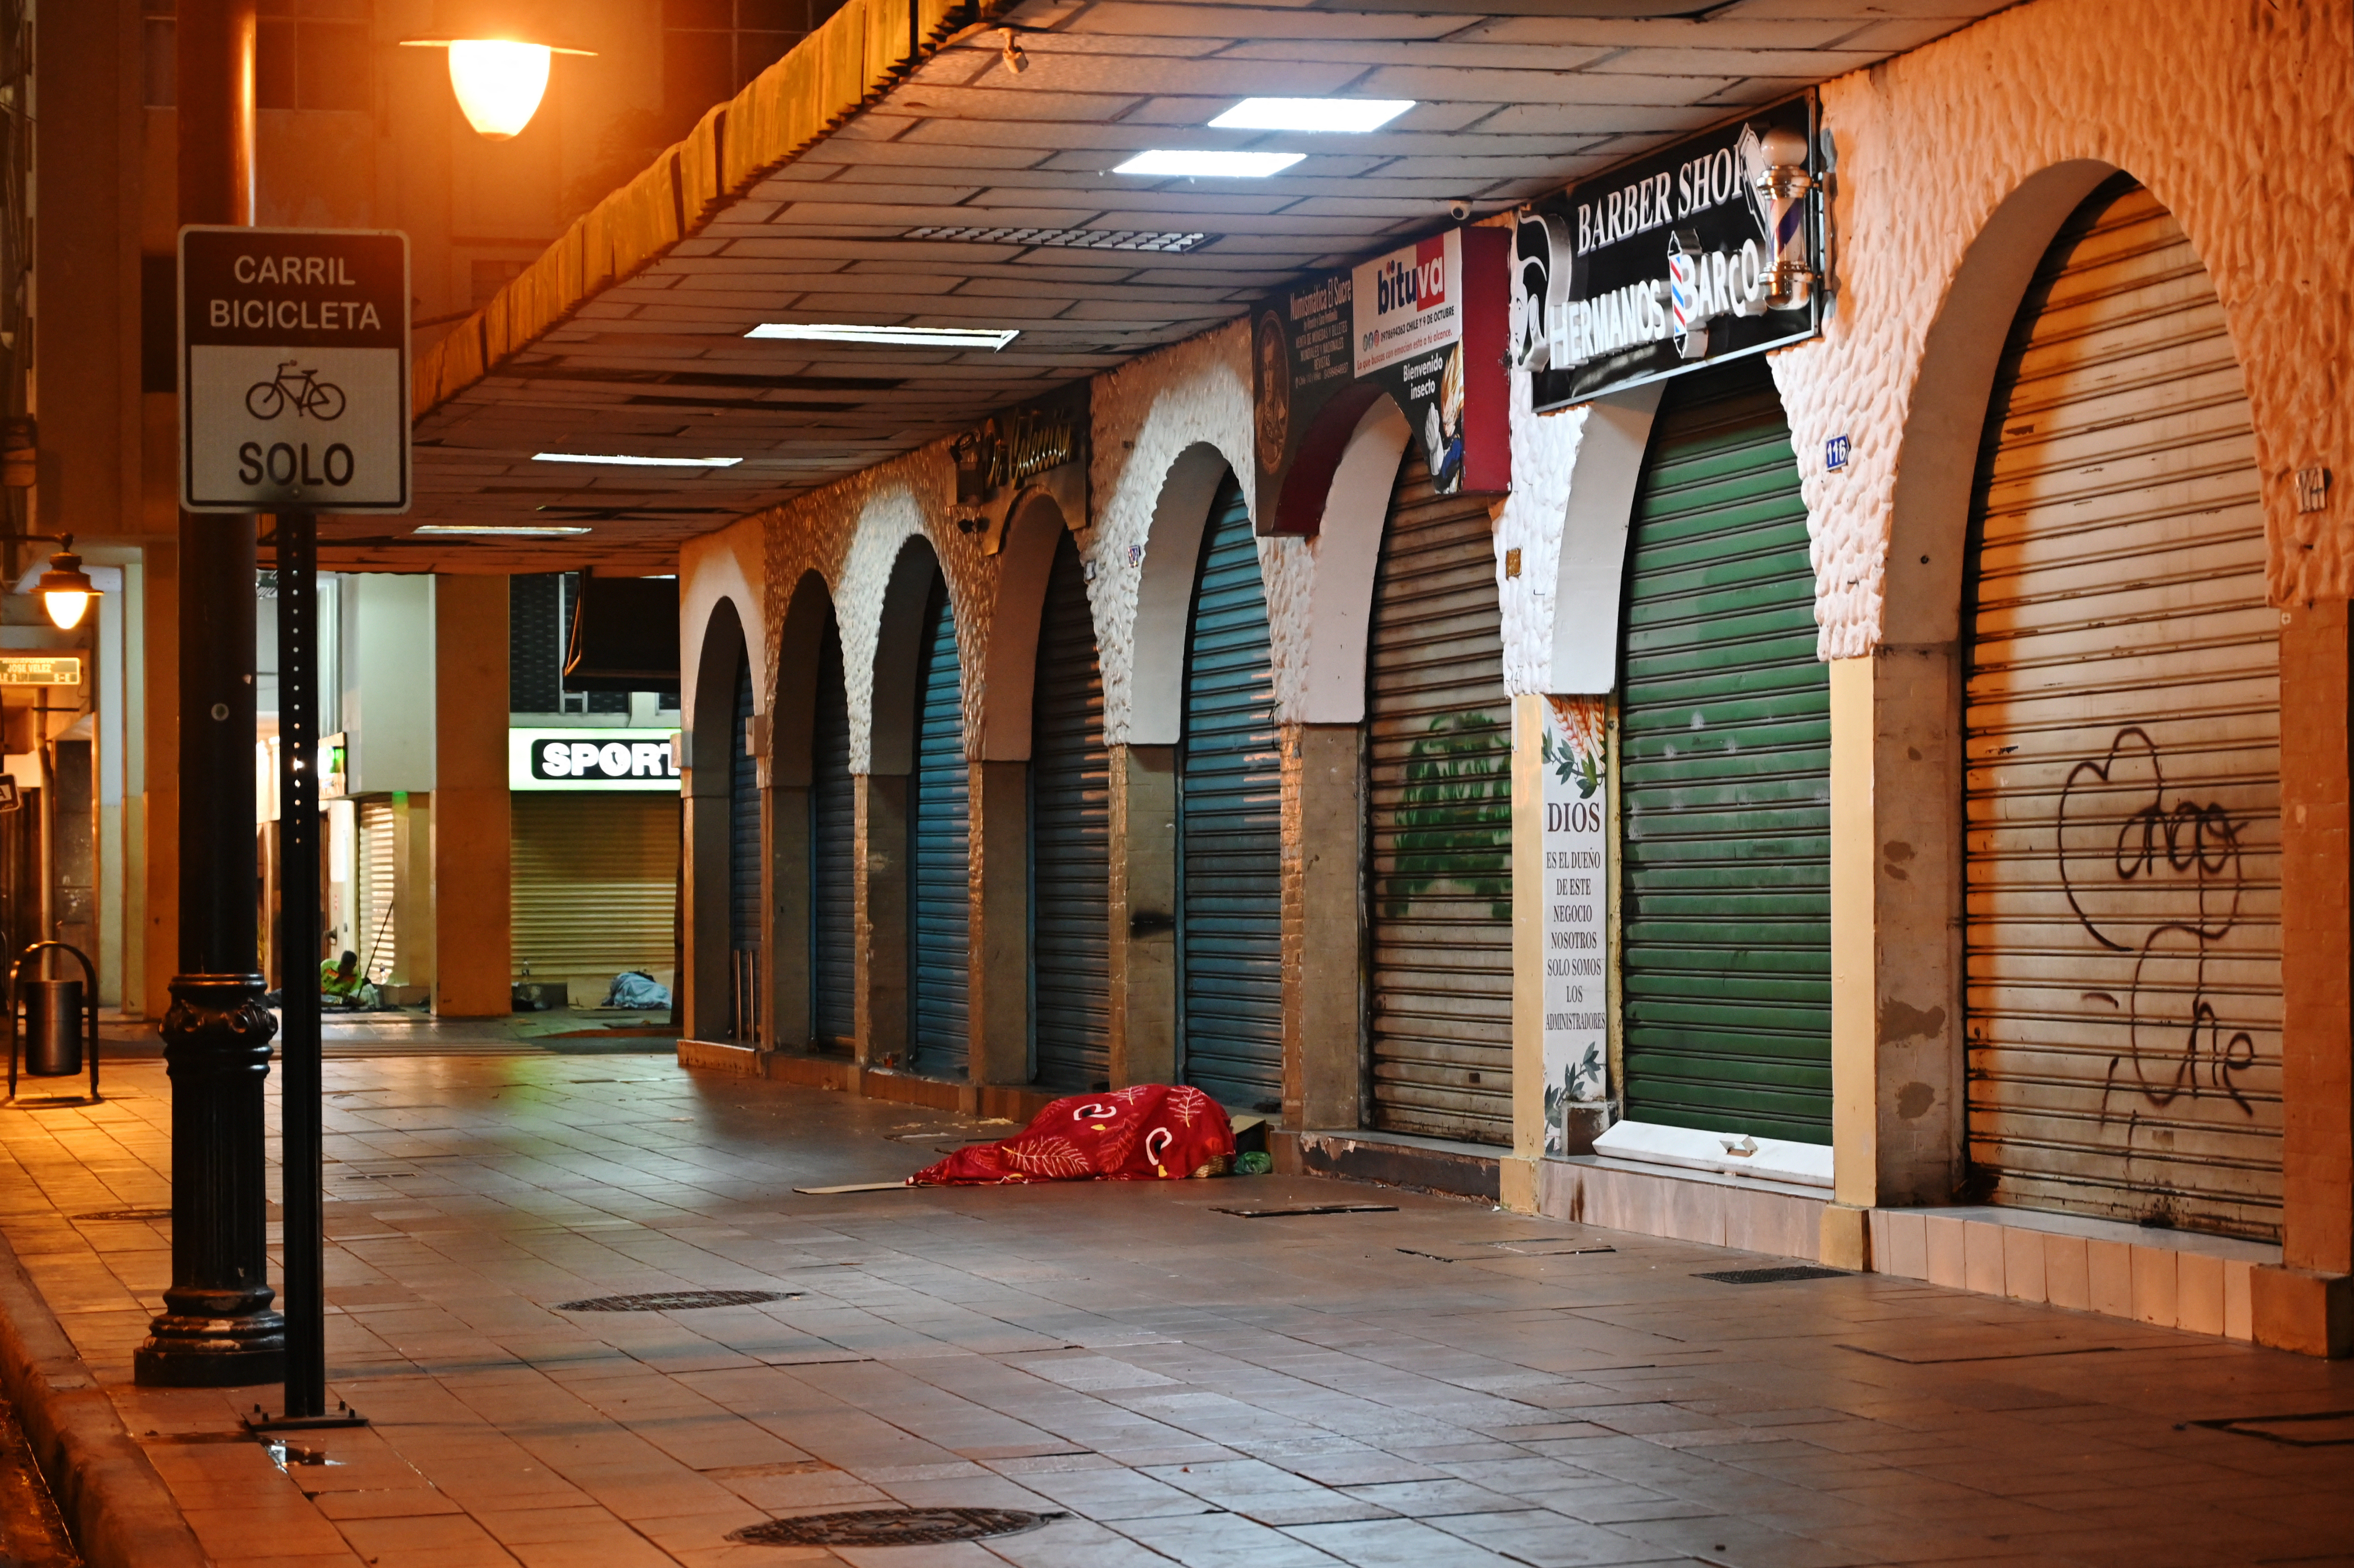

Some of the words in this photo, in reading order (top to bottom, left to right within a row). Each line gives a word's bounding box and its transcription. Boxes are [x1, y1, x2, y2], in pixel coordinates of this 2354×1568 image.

[1578, 171, 1672, 257] BARBER
[234, 255, 355, 285] CARRIL
[1290, 284, 1327, 321] Numismática
[1328, 277, 1333, 308] El
[1334, 276, 1351, 306] Sucre
[1378, 256, 1443, 315] bituva
[210, 300, 381, 329] BICICLETA
[1549, 279, 1665, 370] HERMANOS
[1681, 238, 1760, 324] BARCO
[1406, 318, 1419, 332] CHILE
[1419, 318, 1423, 328] Y
[1423, 316, 1426, 325] 9
[1427, 314, 1433, 325] DE
[1434, 306, 1454, 322] OCTUBRE
[1357, 360, 1363, 370] Lo
[1363, 358, 1371, 370] que
[1371, 353, 1385, 364] buscas
[1413, 336, 1423, 349] está
[1403, 352, 1443, 381] Bienvenido
[1410, 379, 1435, 400] insecto
[238, 442, 354, 486] SOLO
[1828, 439, 1846, 464] 116
[28, 664, 51, 672] VELEZ
[1548, 802, 1600, 833] DIOS
[1547, 852, 1556, 869] ES
[1559, 852, 1569, 869] EL
[1556, 879, 1568, 896] DE
[1570, 879, 1591, 895] ESTE
[1554, 905, 1592, 922] NEGOCIO
[1551, 932, 1597, 949] NOSOTROS
[1548, 959, 1570, 976] SOLO
[1572, 959, 1601, 976] SOMOS
[1566, 986, 1583, 1003] LOS
[1545, 1012, 1606, 1031] ADMINISTRADORES
